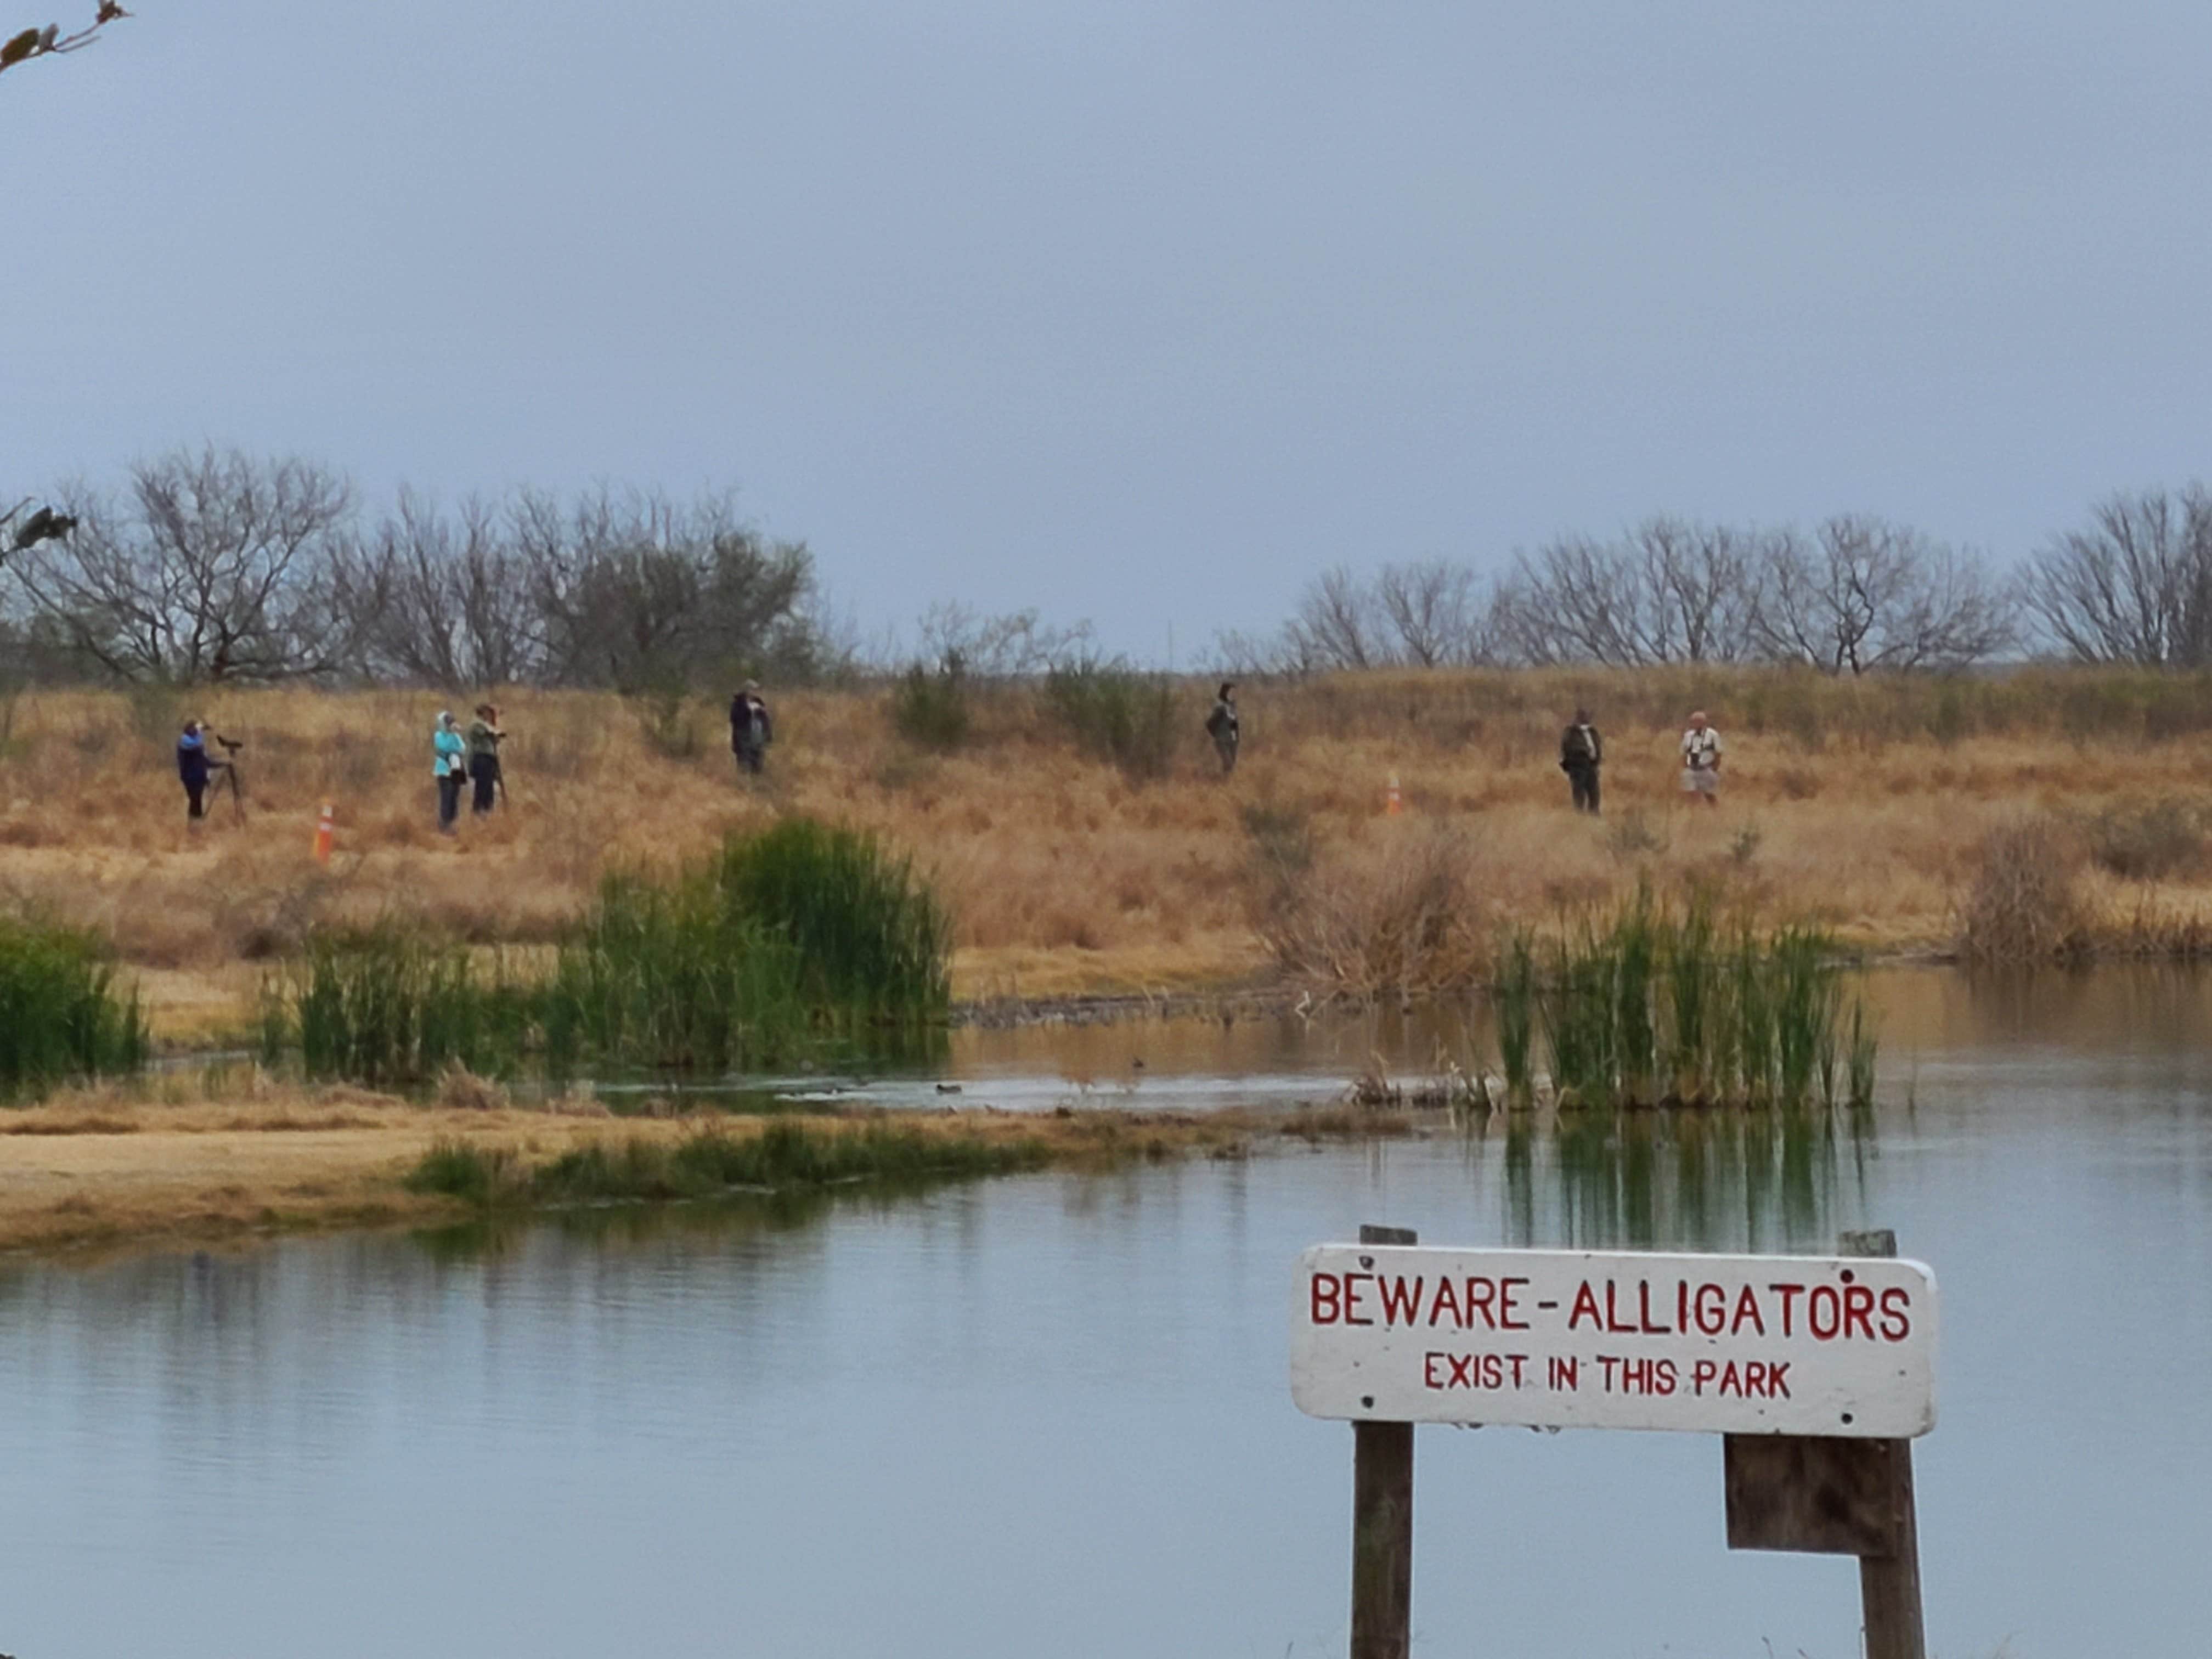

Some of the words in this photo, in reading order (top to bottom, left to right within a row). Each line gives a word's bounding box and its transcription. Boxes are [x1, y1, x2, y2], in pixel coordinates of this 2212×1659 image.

[1424, 1352, 1528, 1390] EXIST
[1548, 1357, 1578, 1391] IN
[1596, 1355, 1676, 1396] THIS
[1695, 1359, 1791, 1399] PARK
